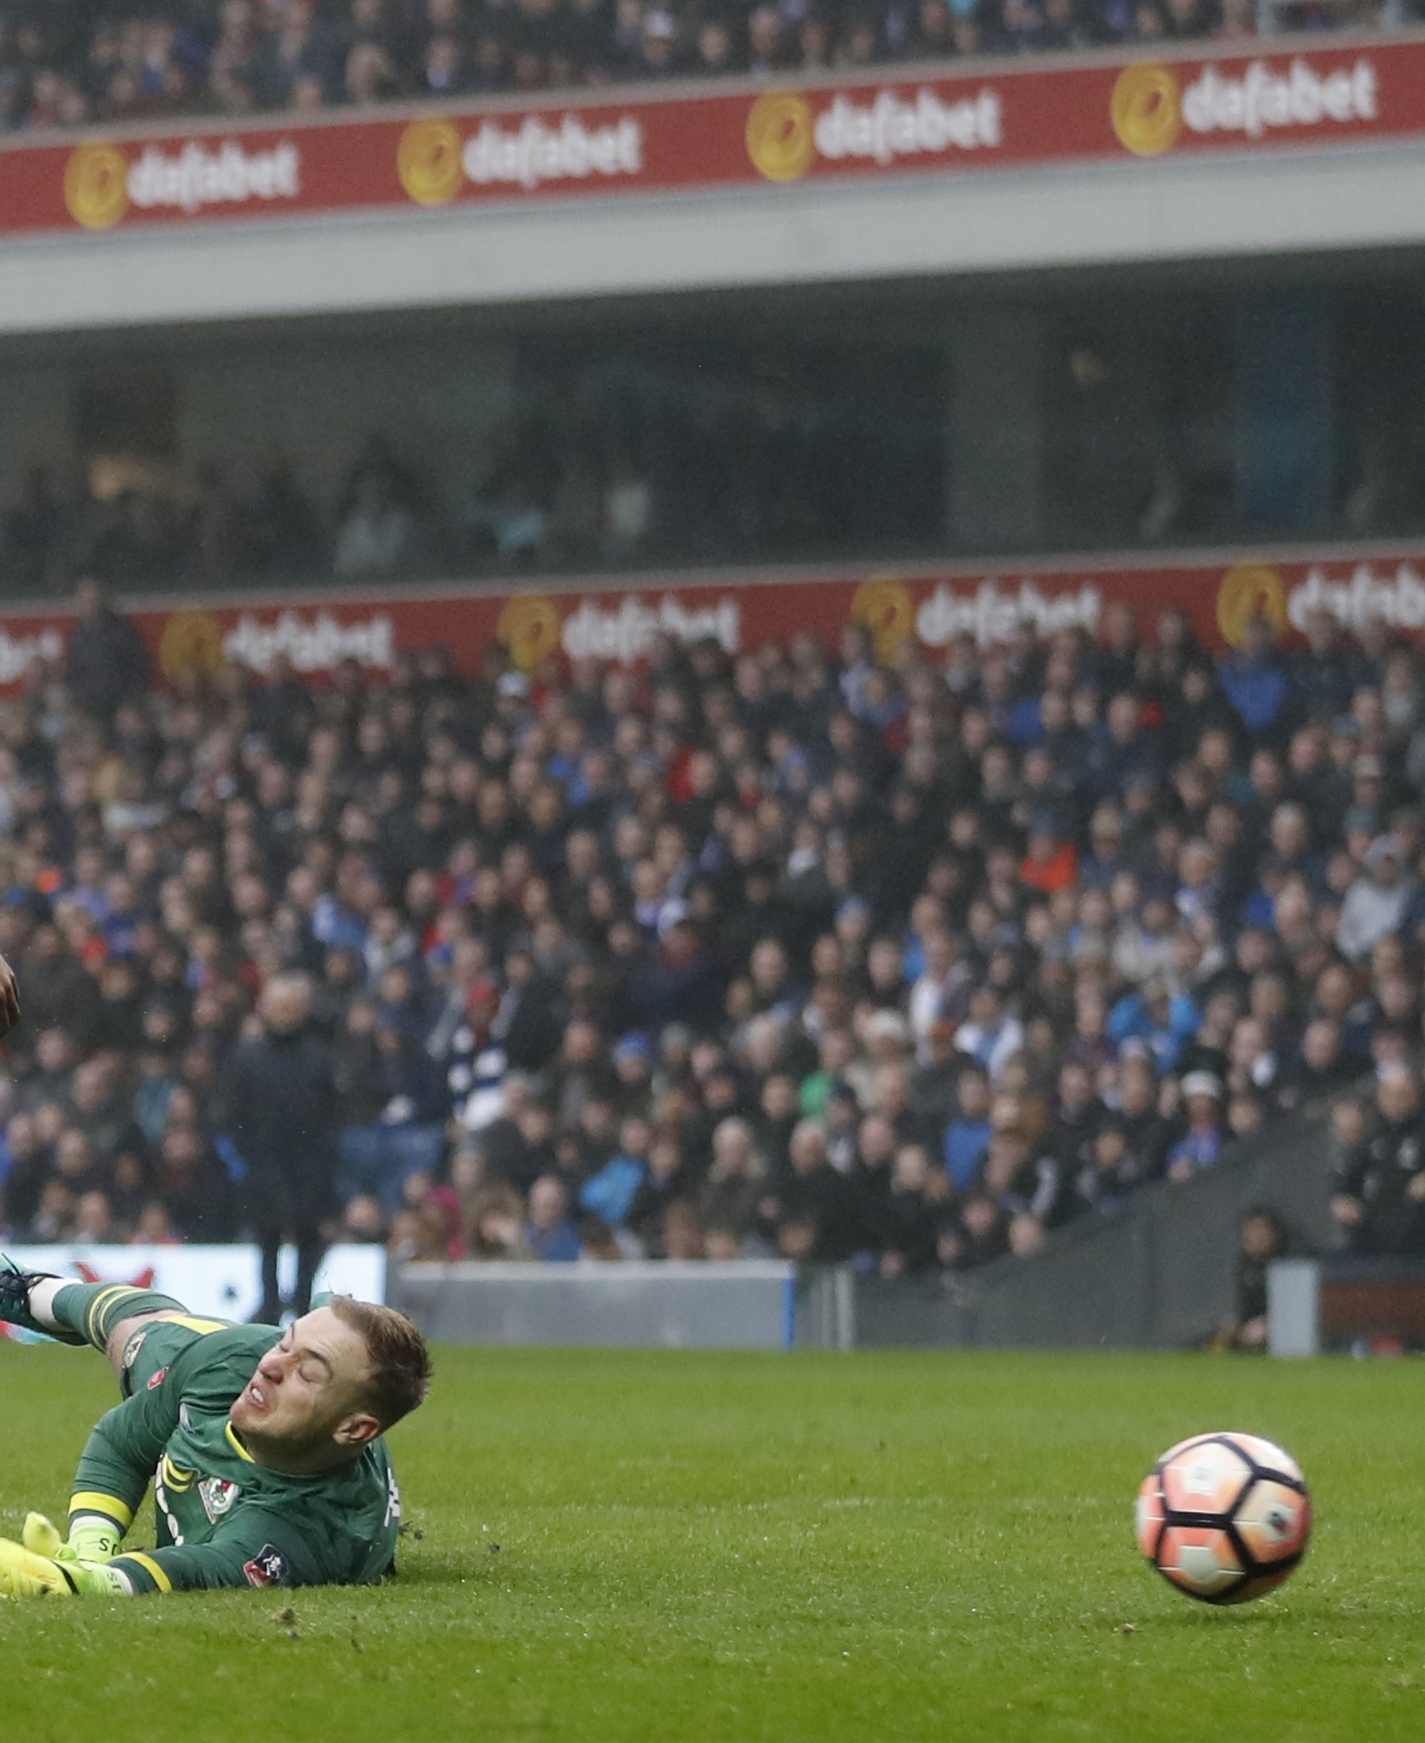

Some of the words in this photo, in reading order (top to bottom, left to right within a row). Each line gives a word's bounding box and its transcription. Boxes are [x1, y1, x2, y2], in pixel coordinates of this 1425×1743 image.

[813, 89, 1001, 163] dafabet
[1180, 60, 1377, 138] dafabet
[461, 116, 642, 190] dafabet
